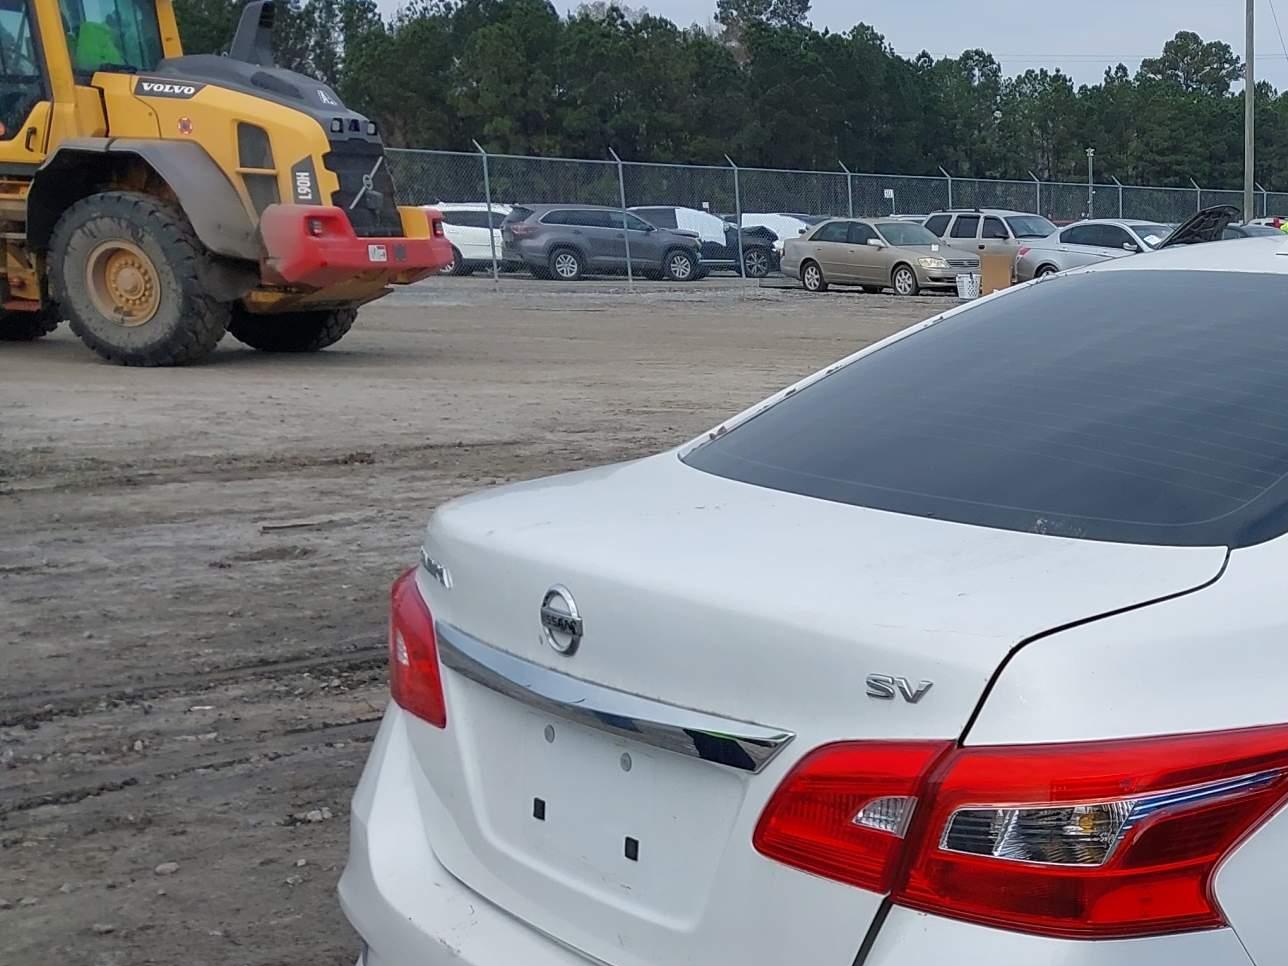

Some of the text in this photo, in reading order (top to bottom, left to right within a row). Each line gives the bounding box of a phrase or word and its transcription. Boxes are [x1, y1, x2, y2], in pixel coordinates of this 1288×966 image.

[141, 82, 196, 95] VOLVO
[295, 171, 313, 200] L90H
[865, 673, 934, 704] SV
